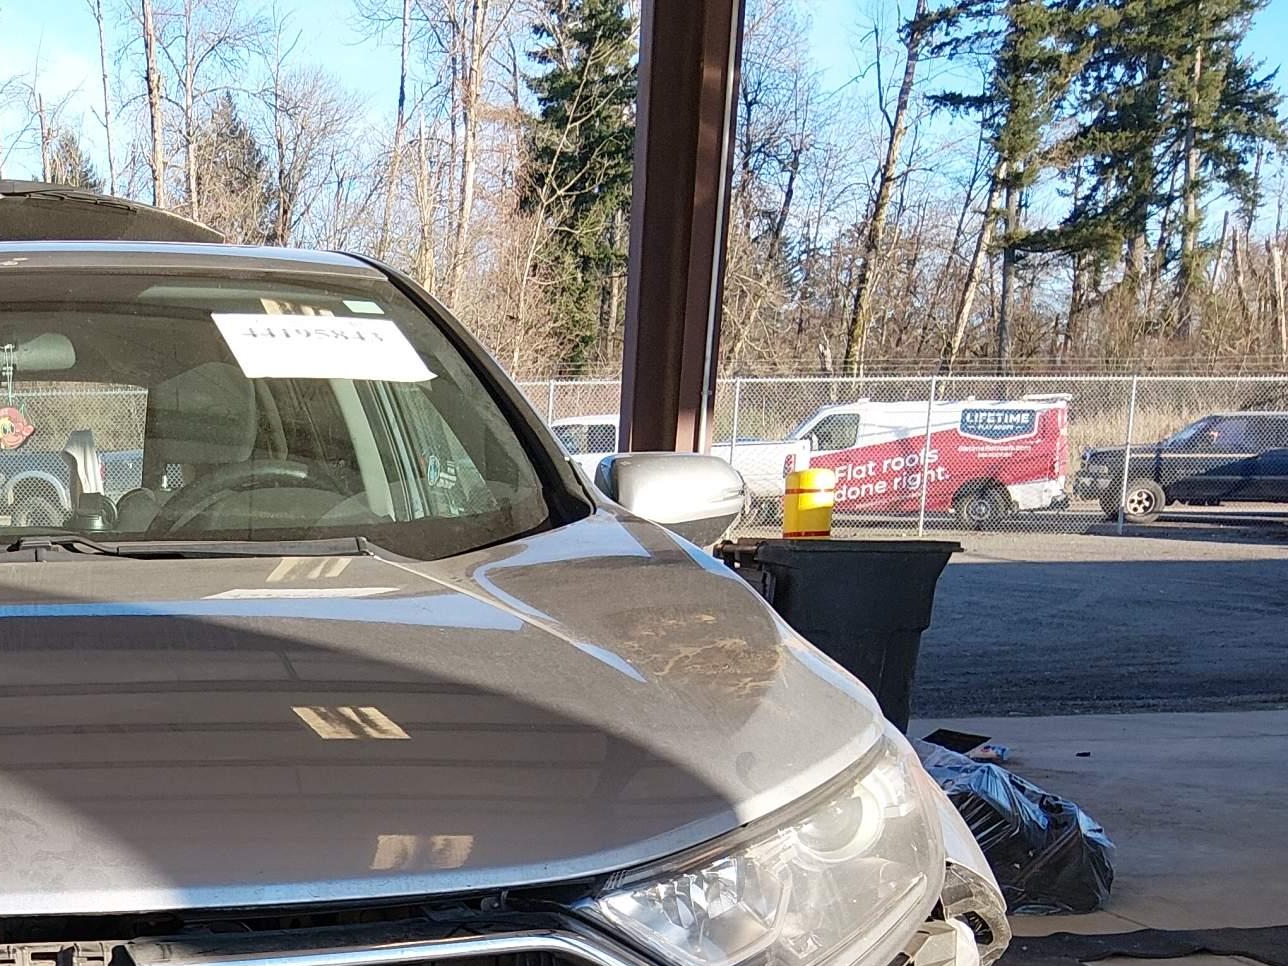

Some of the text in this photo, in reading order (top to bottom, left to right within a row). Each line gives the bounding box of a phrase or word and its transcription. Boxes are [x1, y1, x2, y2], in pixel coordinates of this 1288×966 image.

[965, 412, 1031, 424] LIFETIME
[834, 460, 877, 483] Flat
[833, 480, 888, 502] done
